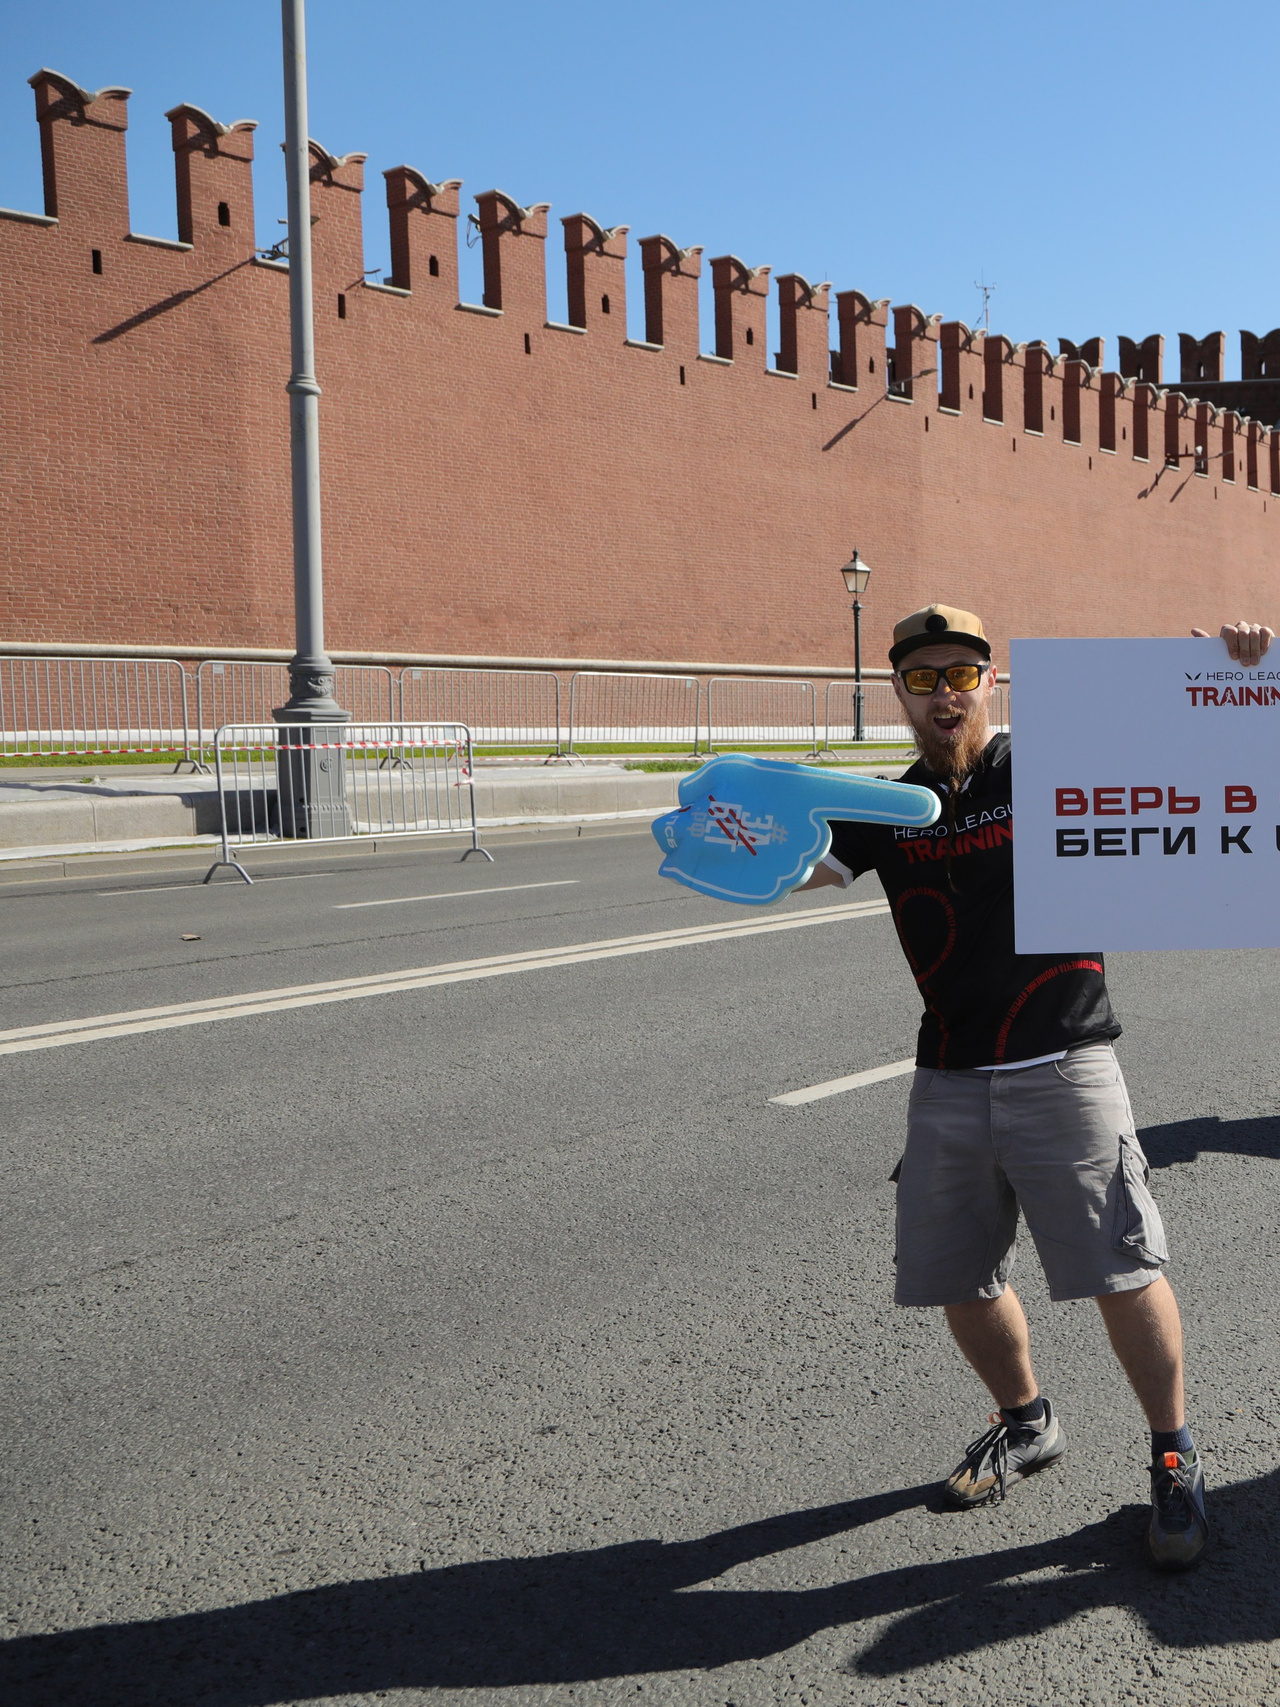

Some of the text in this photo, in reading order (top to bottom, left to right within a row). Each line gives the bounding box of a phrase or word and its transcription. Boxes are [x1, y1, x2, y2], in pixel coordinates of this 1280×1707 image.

[1206, 671, 1244, 681] HERO
[1055, 786, 1200, 816] ВЕРЬ
[1224, 785, 1257, 813] В
[894, 825, 948, 840] HERO
[897, 818, 1014, 864] TRAININ
[1056, 826, 1196, 857] БЕГИ
[1221, 825, 1253, 854] К
